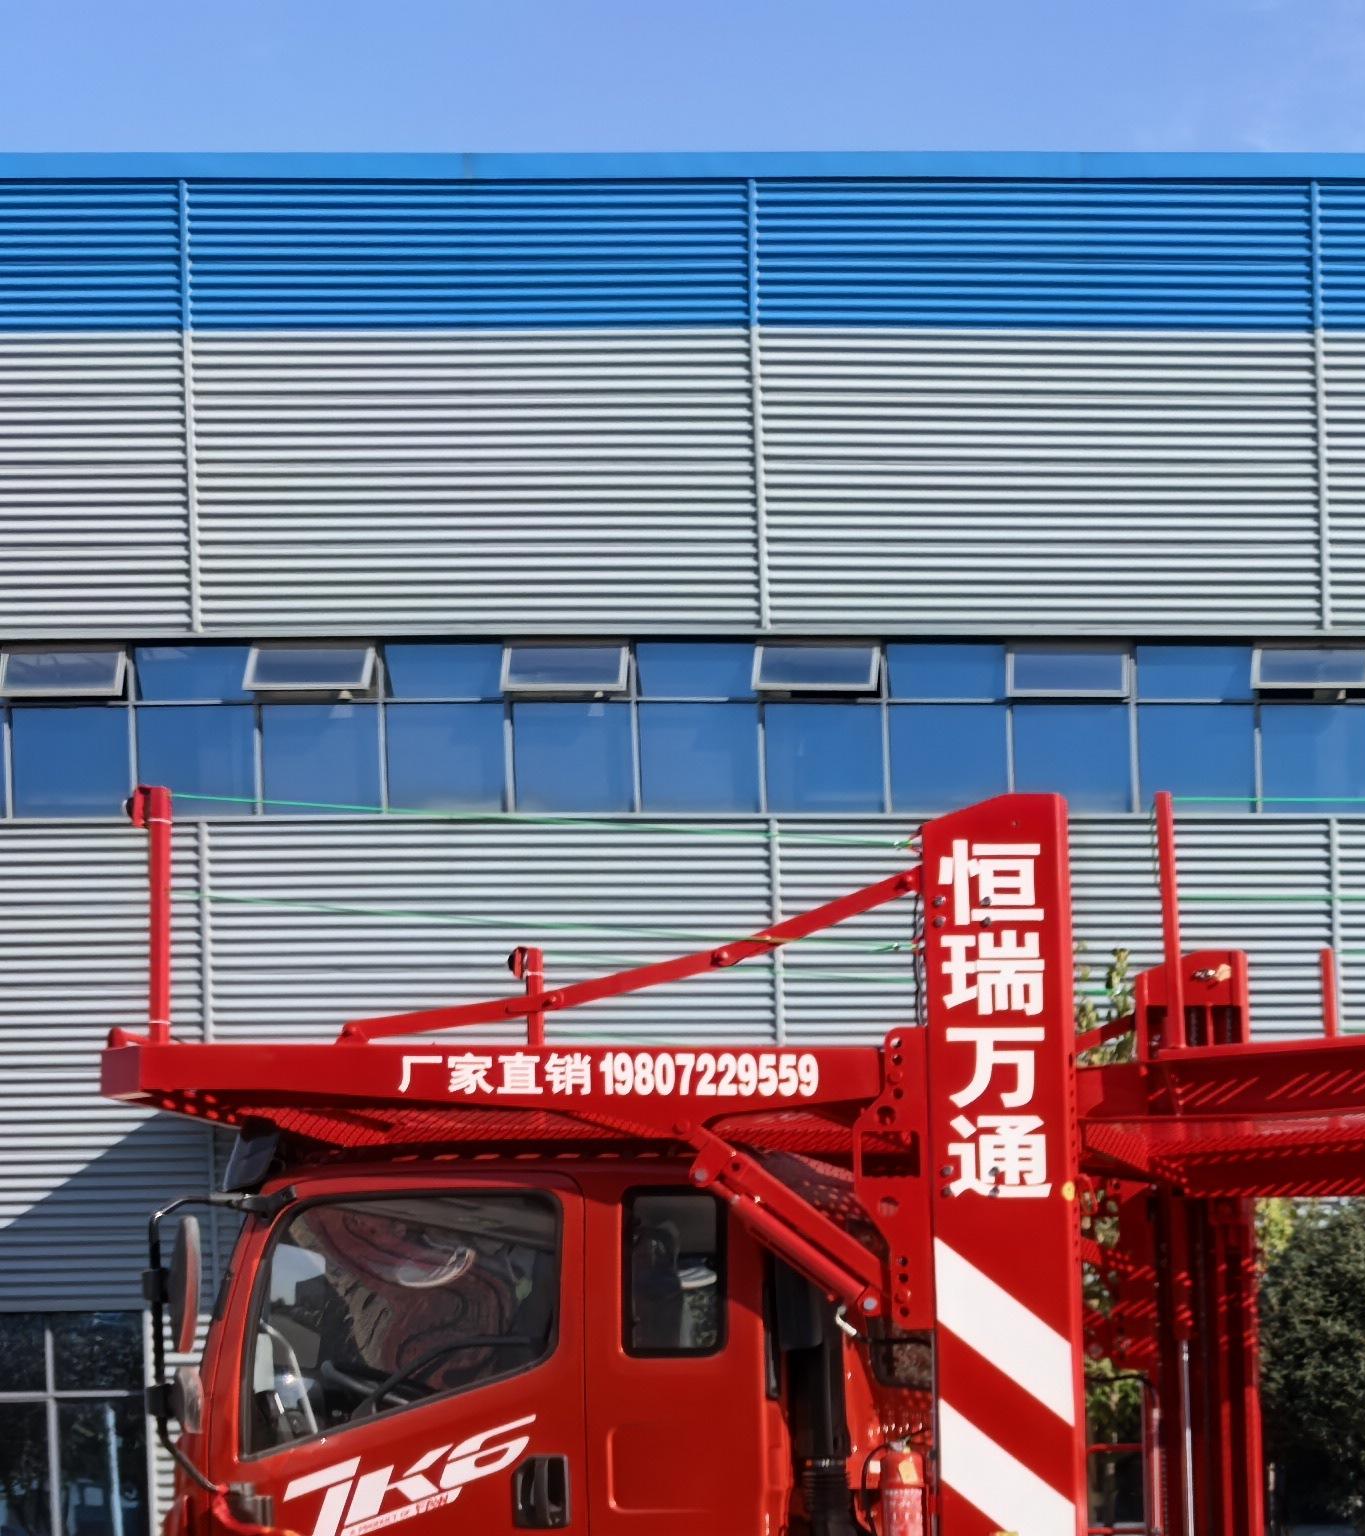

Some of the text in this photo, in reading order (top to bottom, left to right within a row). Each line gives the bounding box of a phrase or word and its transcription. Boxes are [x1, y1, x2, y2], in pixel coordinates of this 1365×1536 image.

[398, 1052, 820, 1097] 厂家直销 19807229559
[938, 839, 1053, 1200] 恒瑞万通
